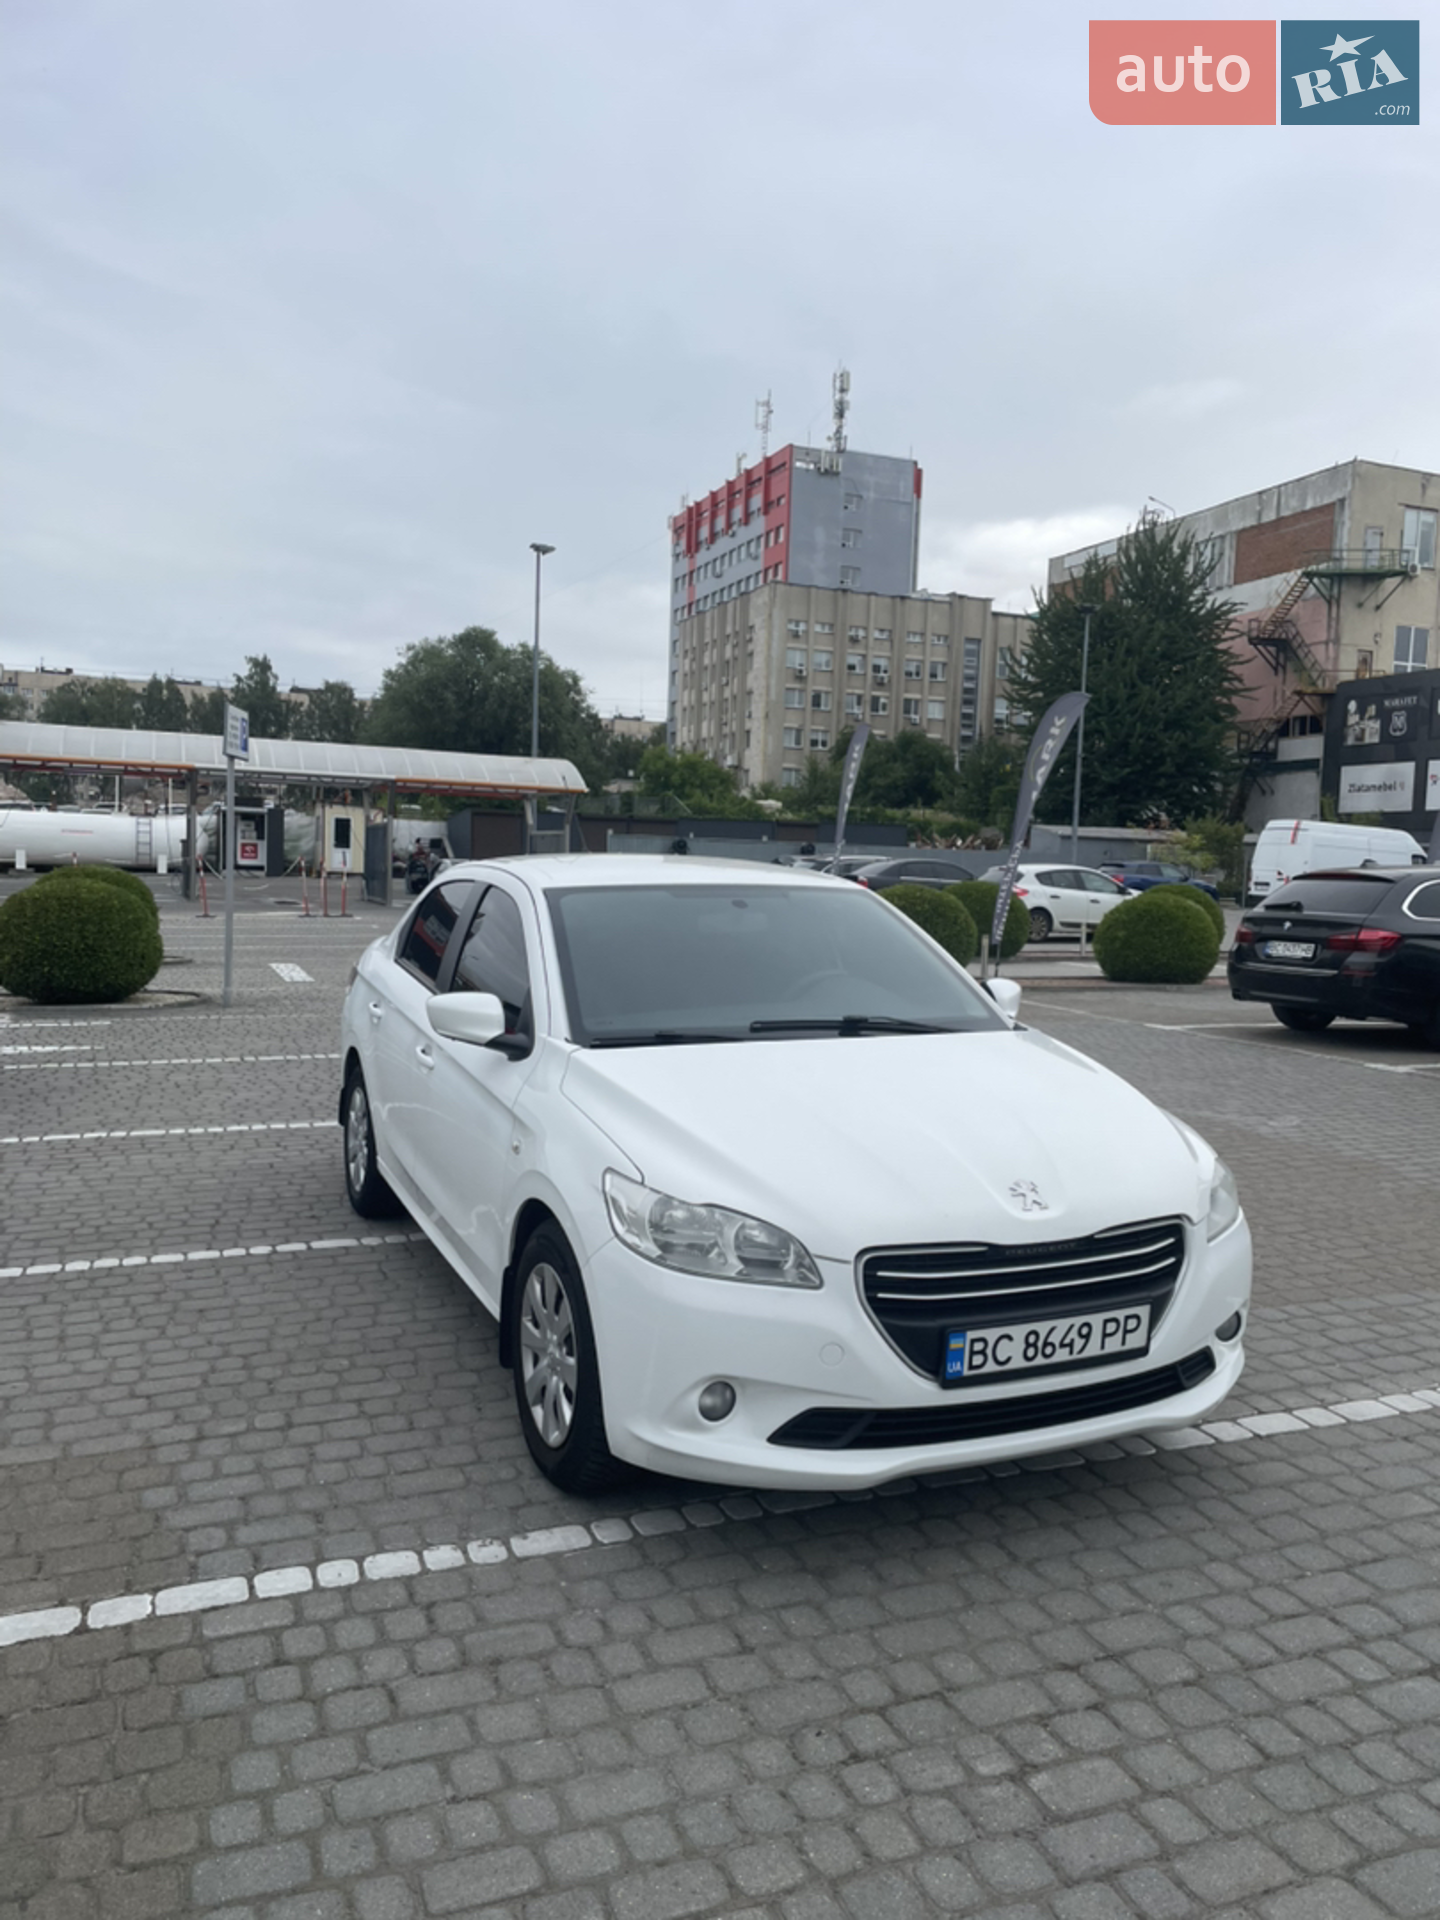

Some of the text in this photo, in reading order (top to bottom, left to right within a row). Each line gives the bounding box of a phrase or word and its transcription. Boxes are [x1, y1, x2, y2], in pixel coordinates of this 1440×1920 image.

[967, 1313, 1142, 1371] BC 8649 PP
